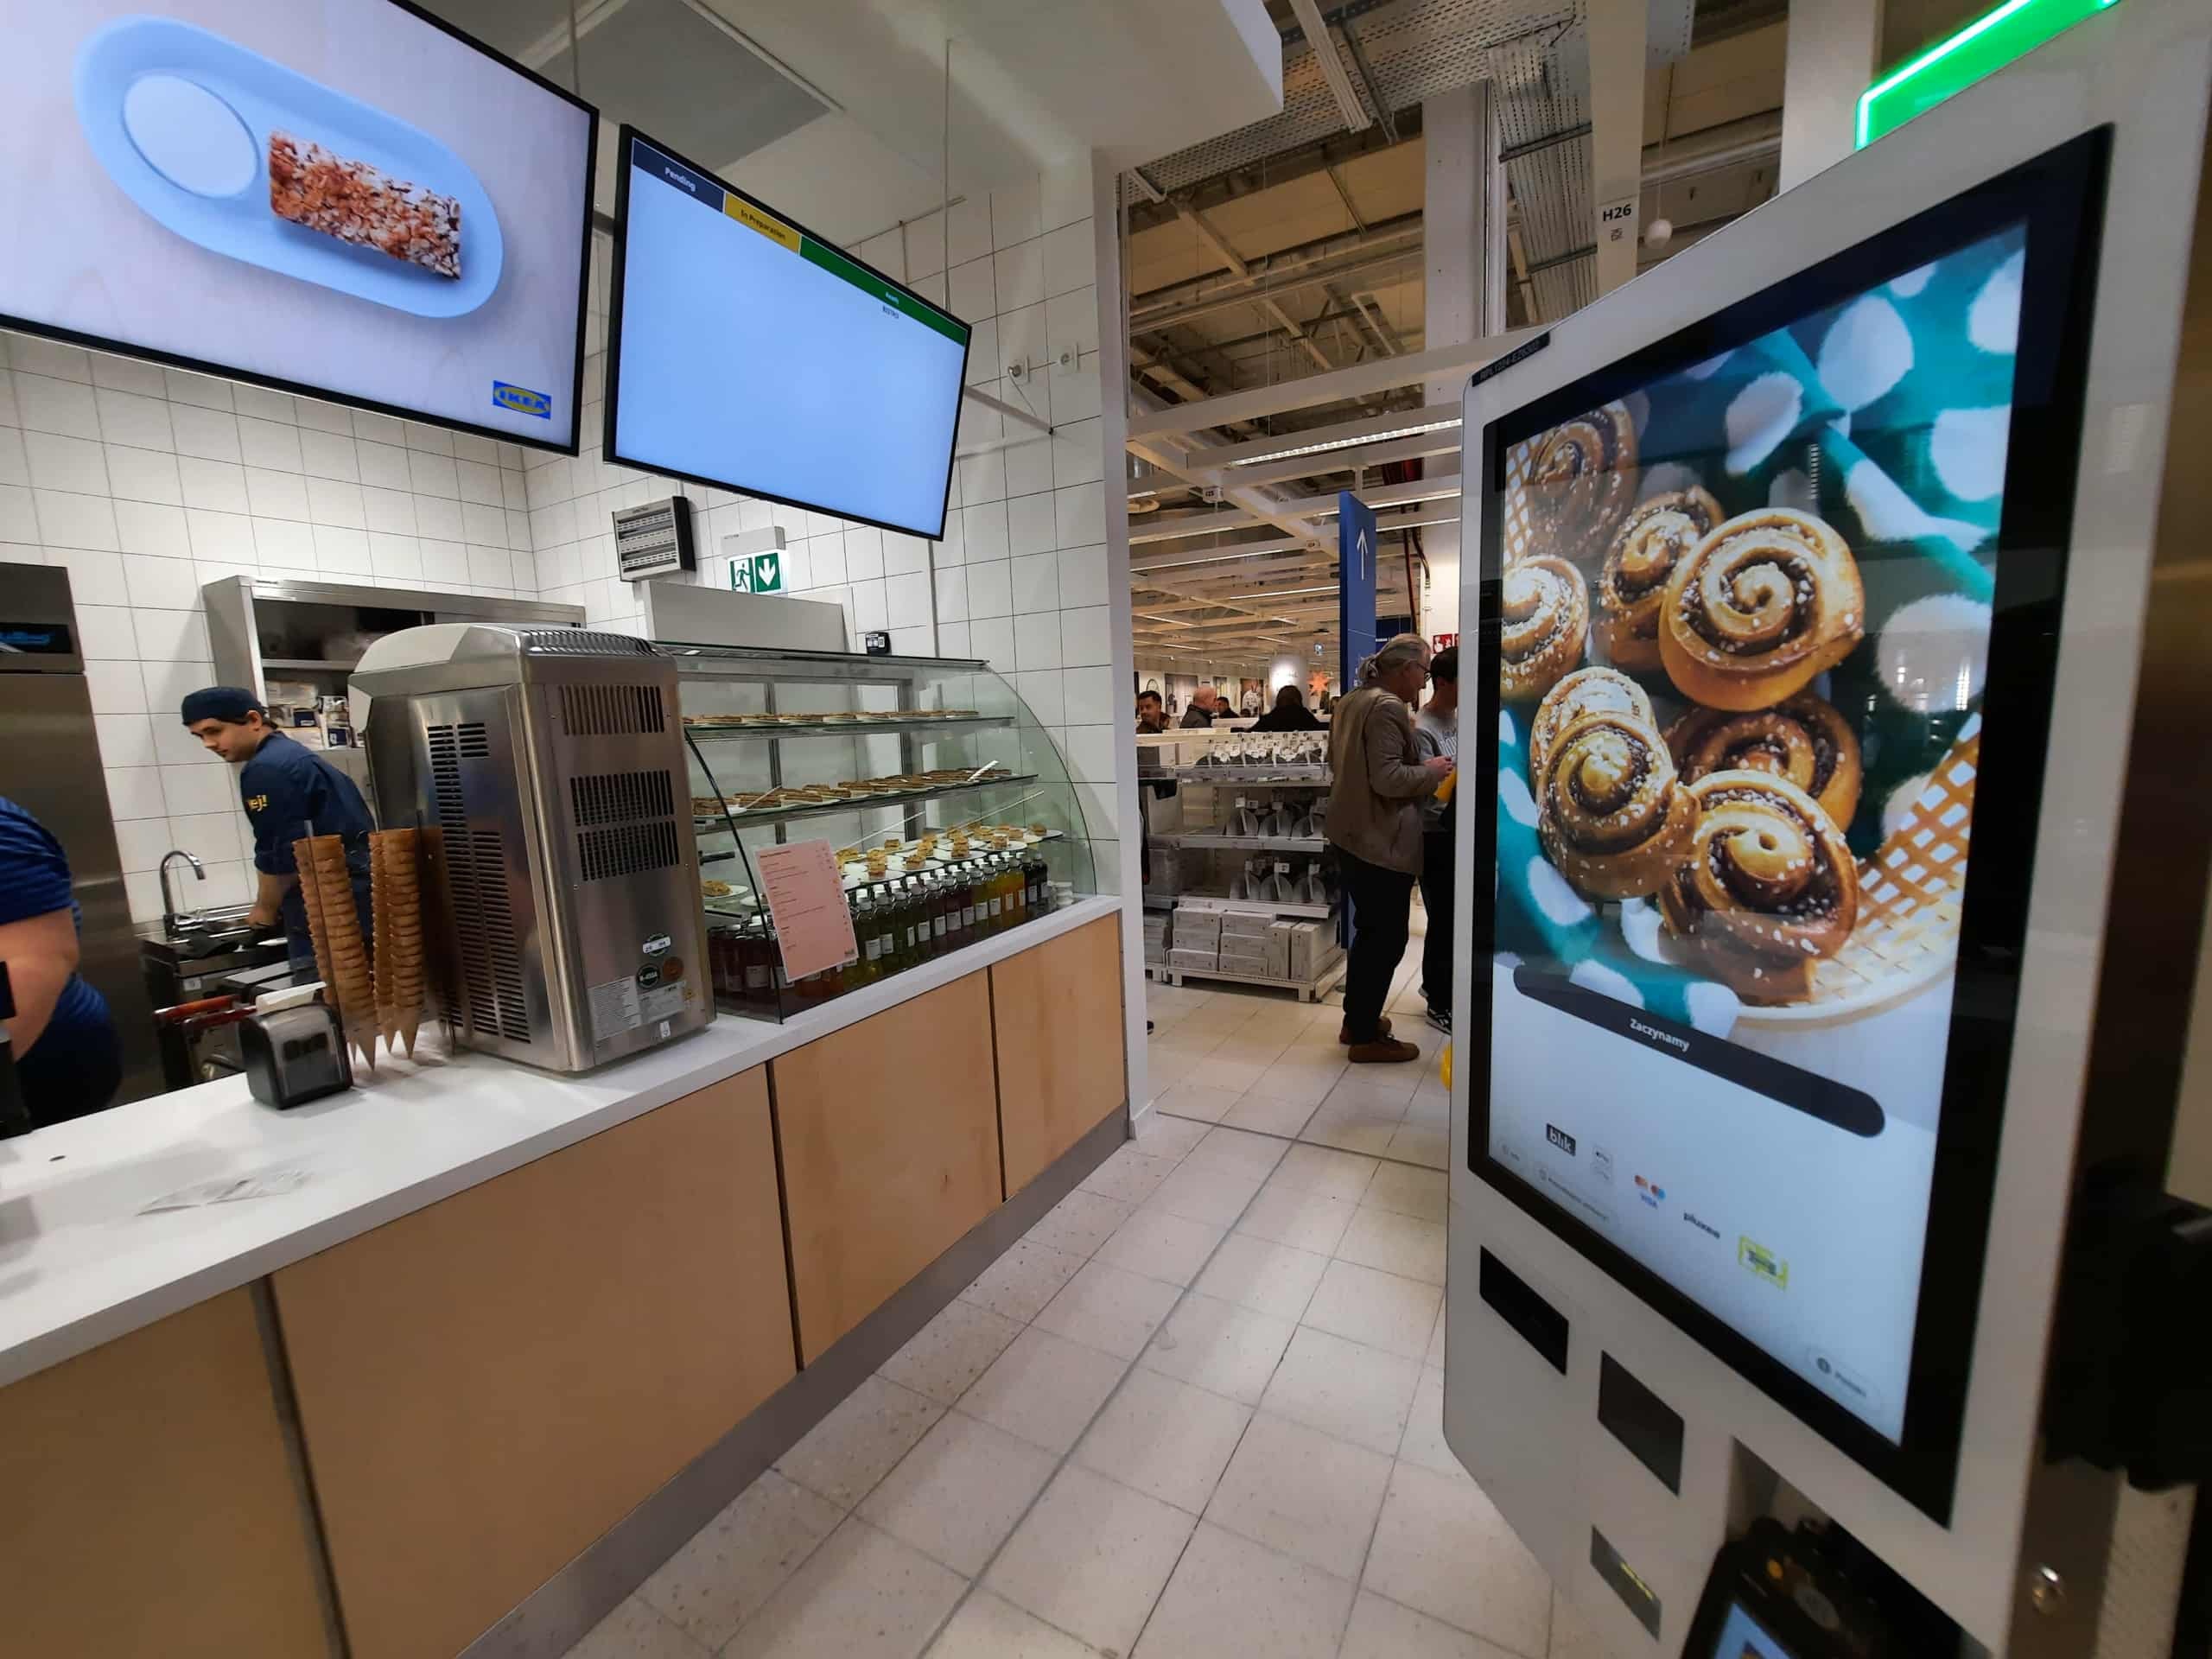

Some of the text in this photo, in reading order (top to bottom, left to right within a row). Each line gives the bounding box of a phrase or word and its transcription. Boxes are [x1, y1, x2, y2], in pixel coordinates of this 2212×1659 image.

[664, 167, 696, 193] Pending
[1603, 203, 1632, 222] H26
[749, 215, 787, 241] Preparation
[247, 794, 269, 812] ej!
[1630, 1018, 1690, 1052] Zaczynamy
[1548, 1127, 1573, 1153] blik
